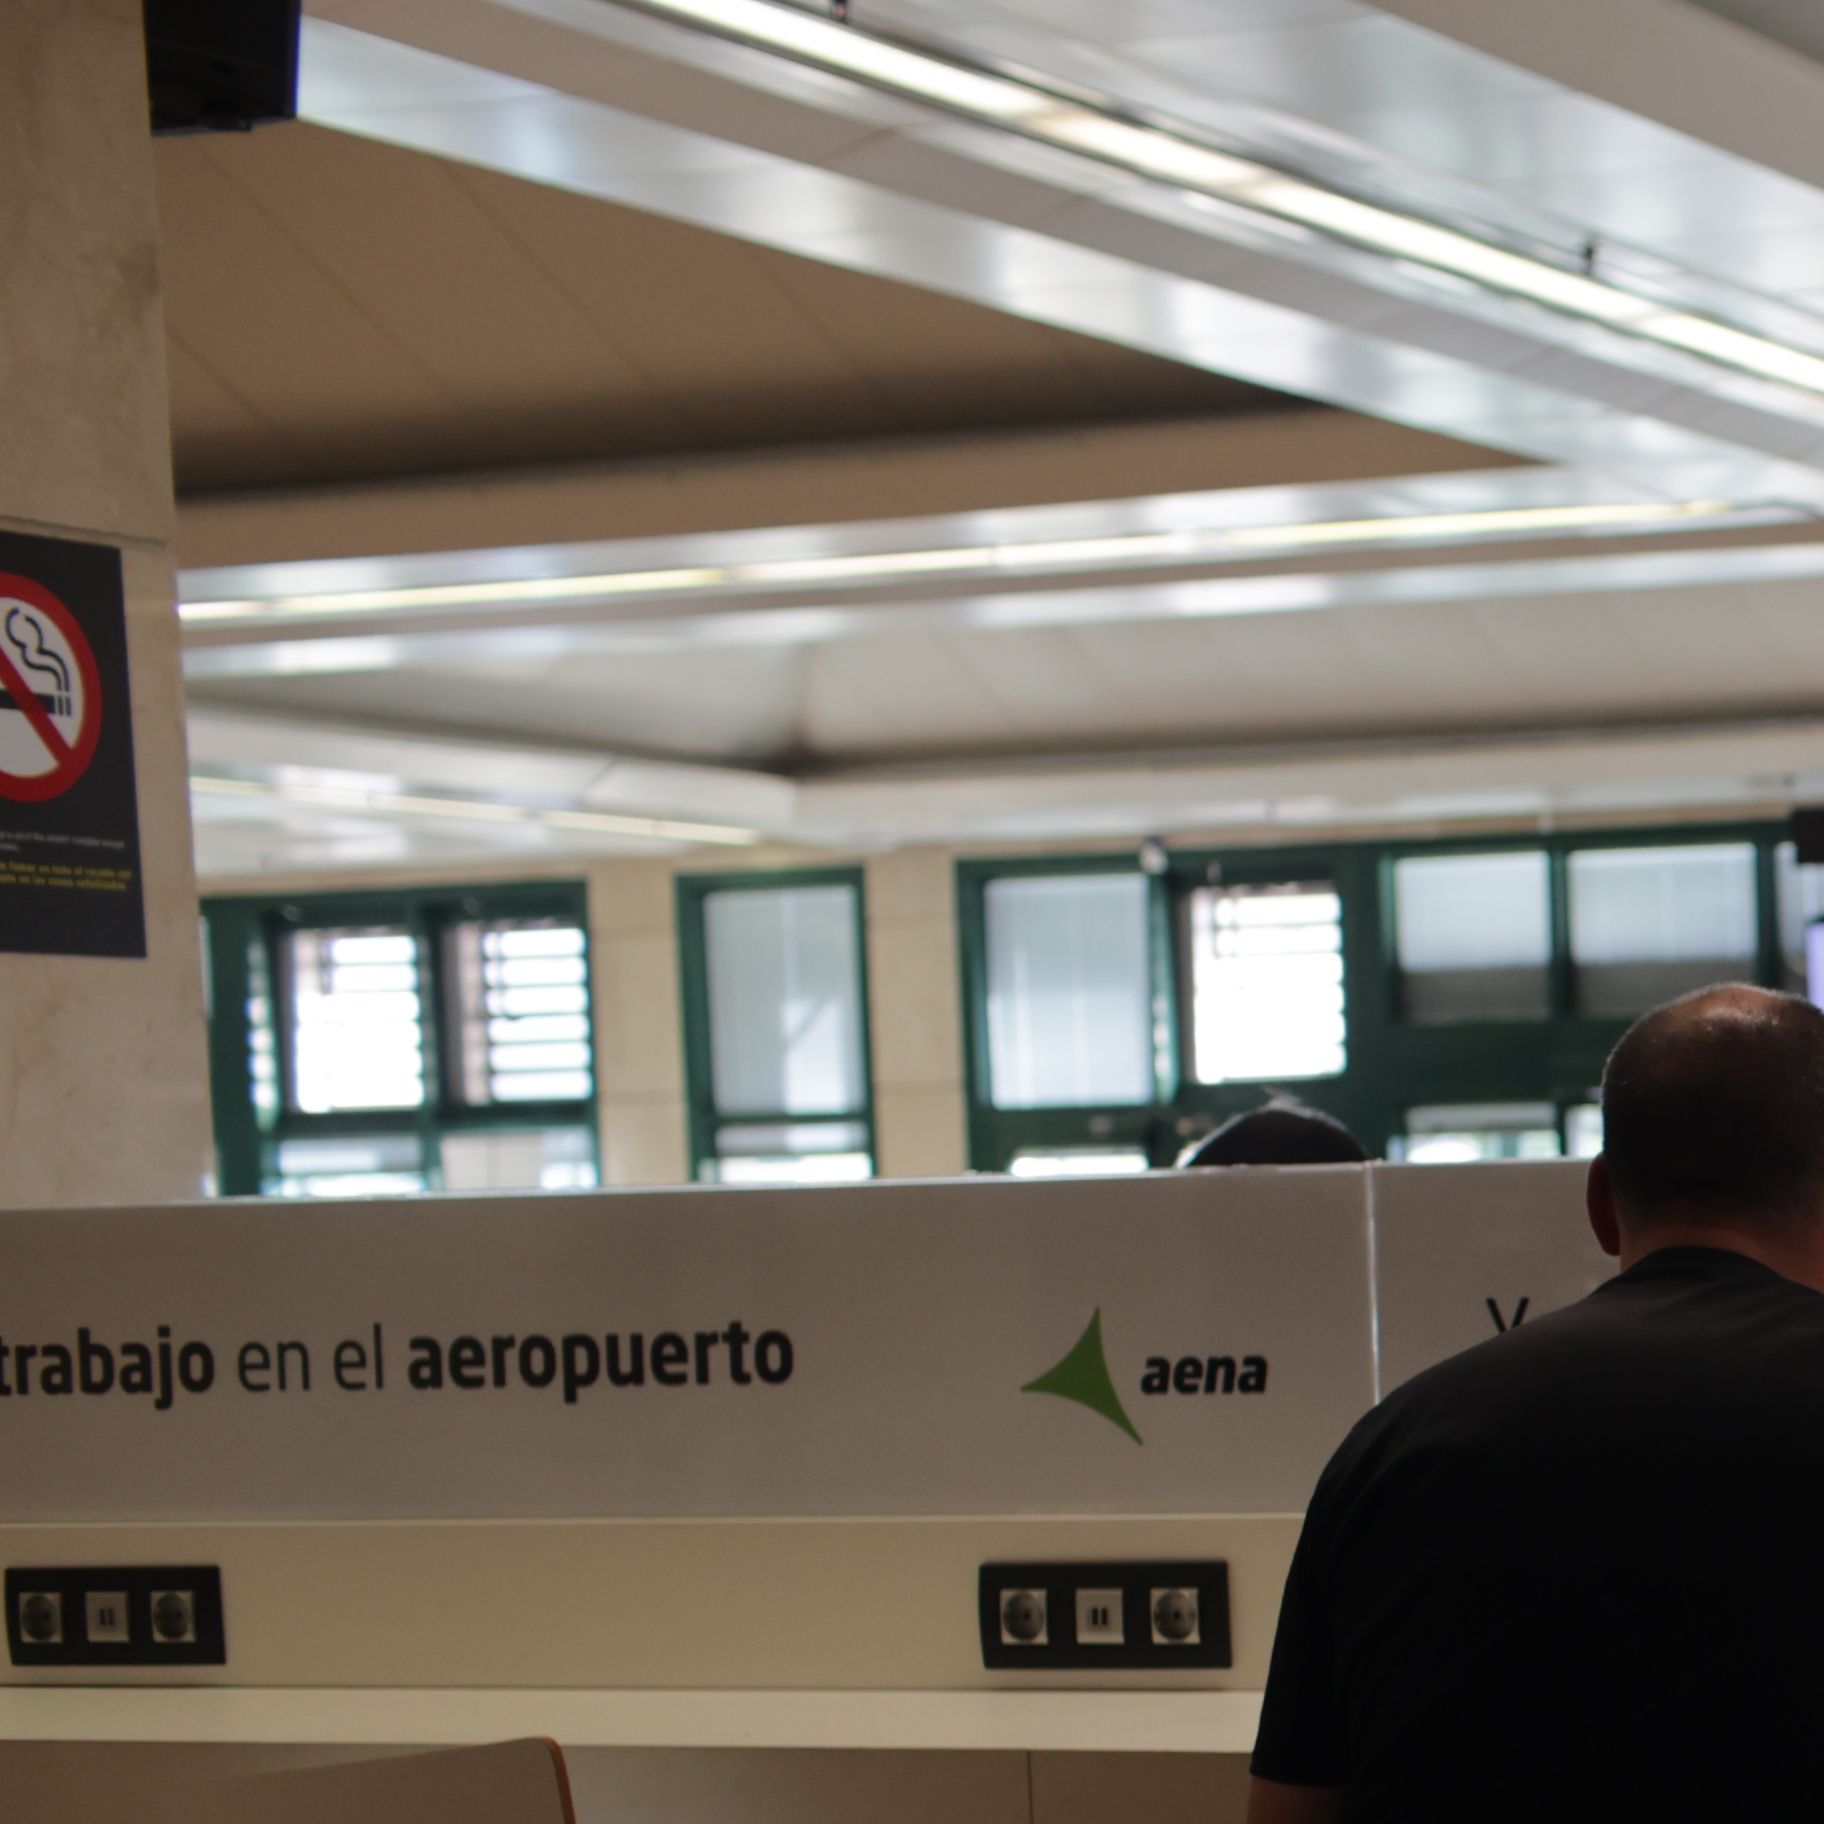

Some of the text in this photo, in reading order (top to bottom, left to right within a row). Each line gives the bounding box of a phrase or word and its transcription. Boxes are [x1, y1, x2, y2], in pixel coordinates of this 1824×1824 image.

[237, 1341, 310, 1393] en
[333, 1322, 385, 1391] el
[408, 1320, 794, 1404] aeropuerto
[1141, 1355, 1268, 1395] aena
